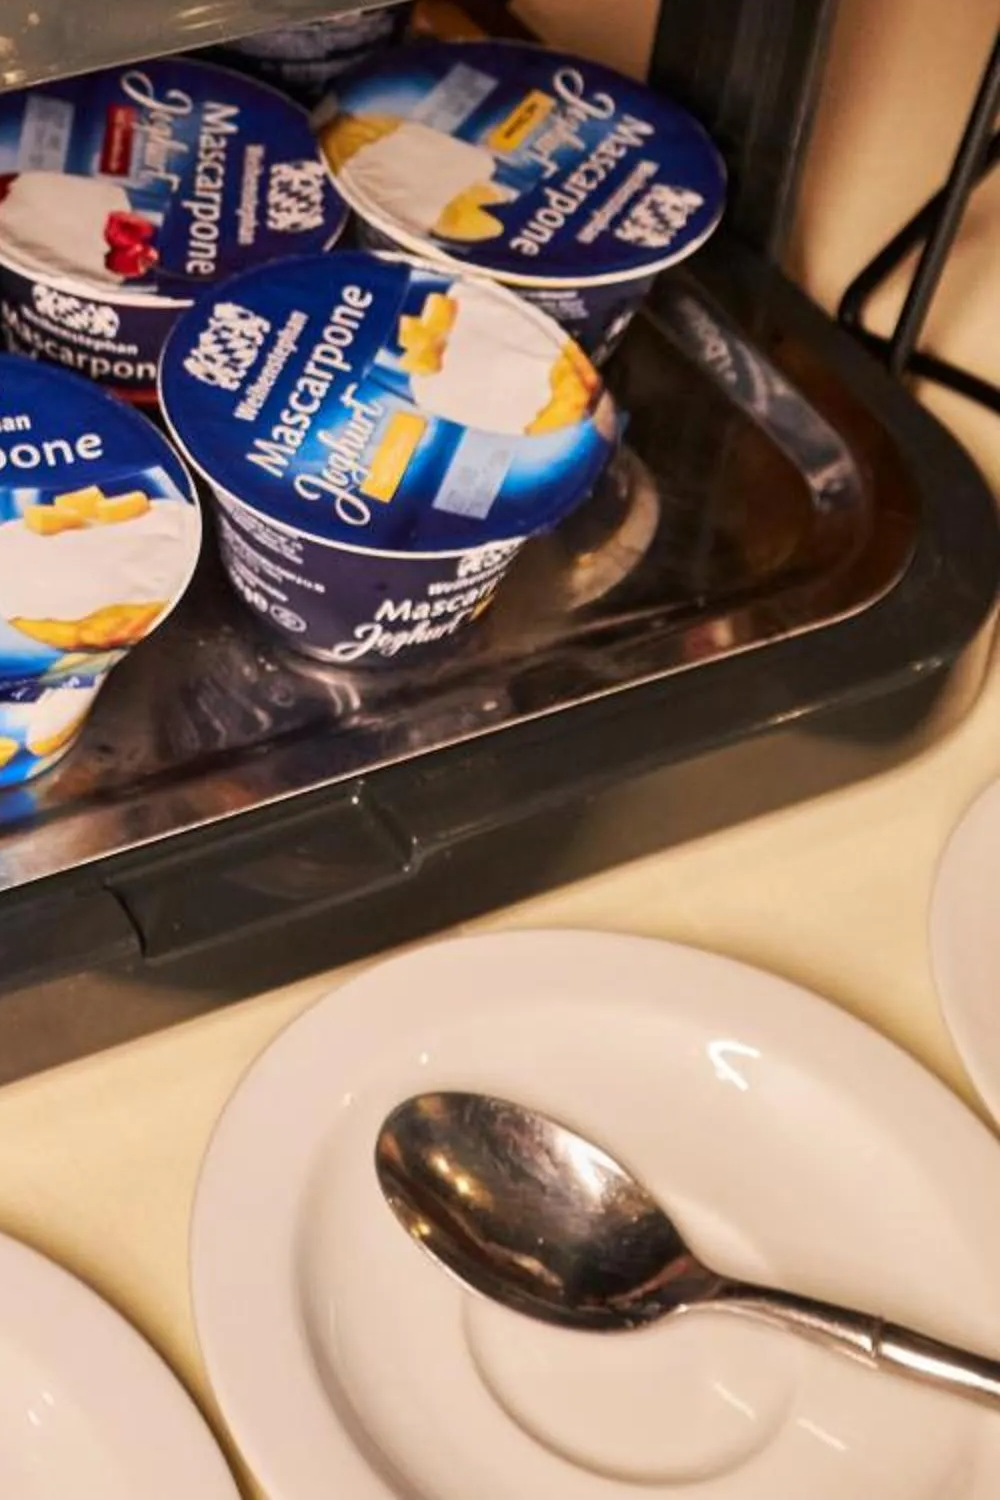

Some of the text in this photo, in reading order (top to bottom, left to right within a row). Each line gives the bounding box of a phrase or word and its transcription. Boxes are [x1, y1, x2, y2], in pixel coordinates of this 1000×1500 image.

[182, 100, 240, 276] Mascarpone
[508, 113, 656, 257] Mascarpone
[245, 283, 374, 479] Mascarpone
[293, 380, 387, 527] Joghurt
